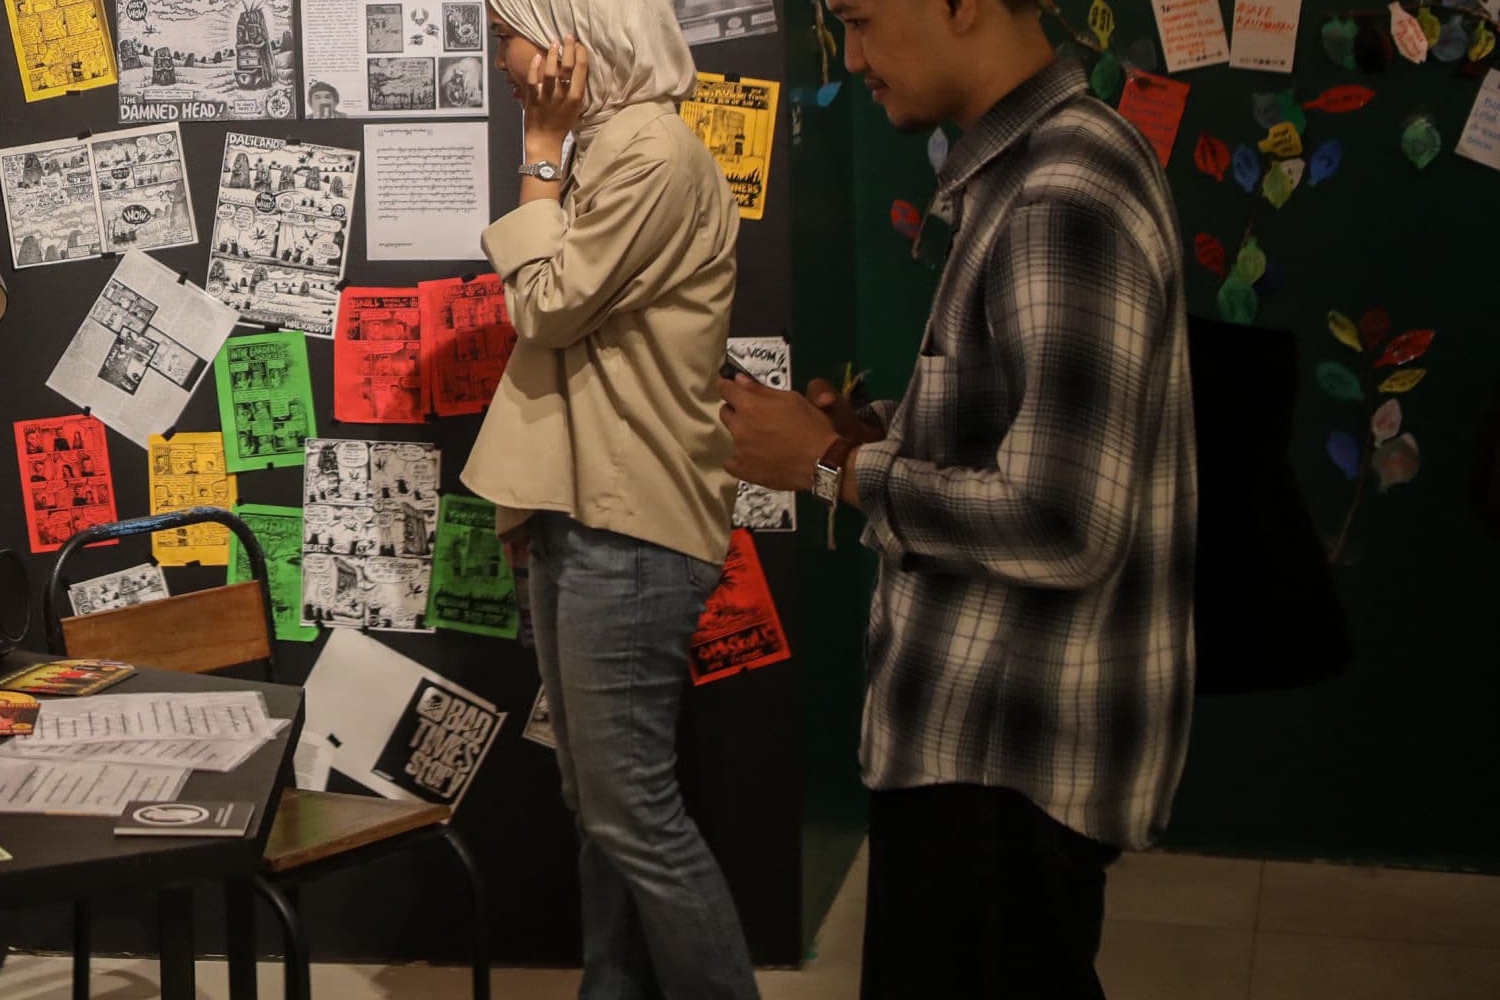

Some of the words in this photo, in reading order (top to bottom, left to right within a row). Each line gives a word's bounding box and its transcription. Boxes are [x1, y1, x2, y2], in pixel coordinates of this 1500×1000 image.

[120, 104, 179, 120] DAMNED
[122, 96, 137, 104] THE
[442, 697, 494, 746] BAD
[408, 718, 481, 774] TIMES
